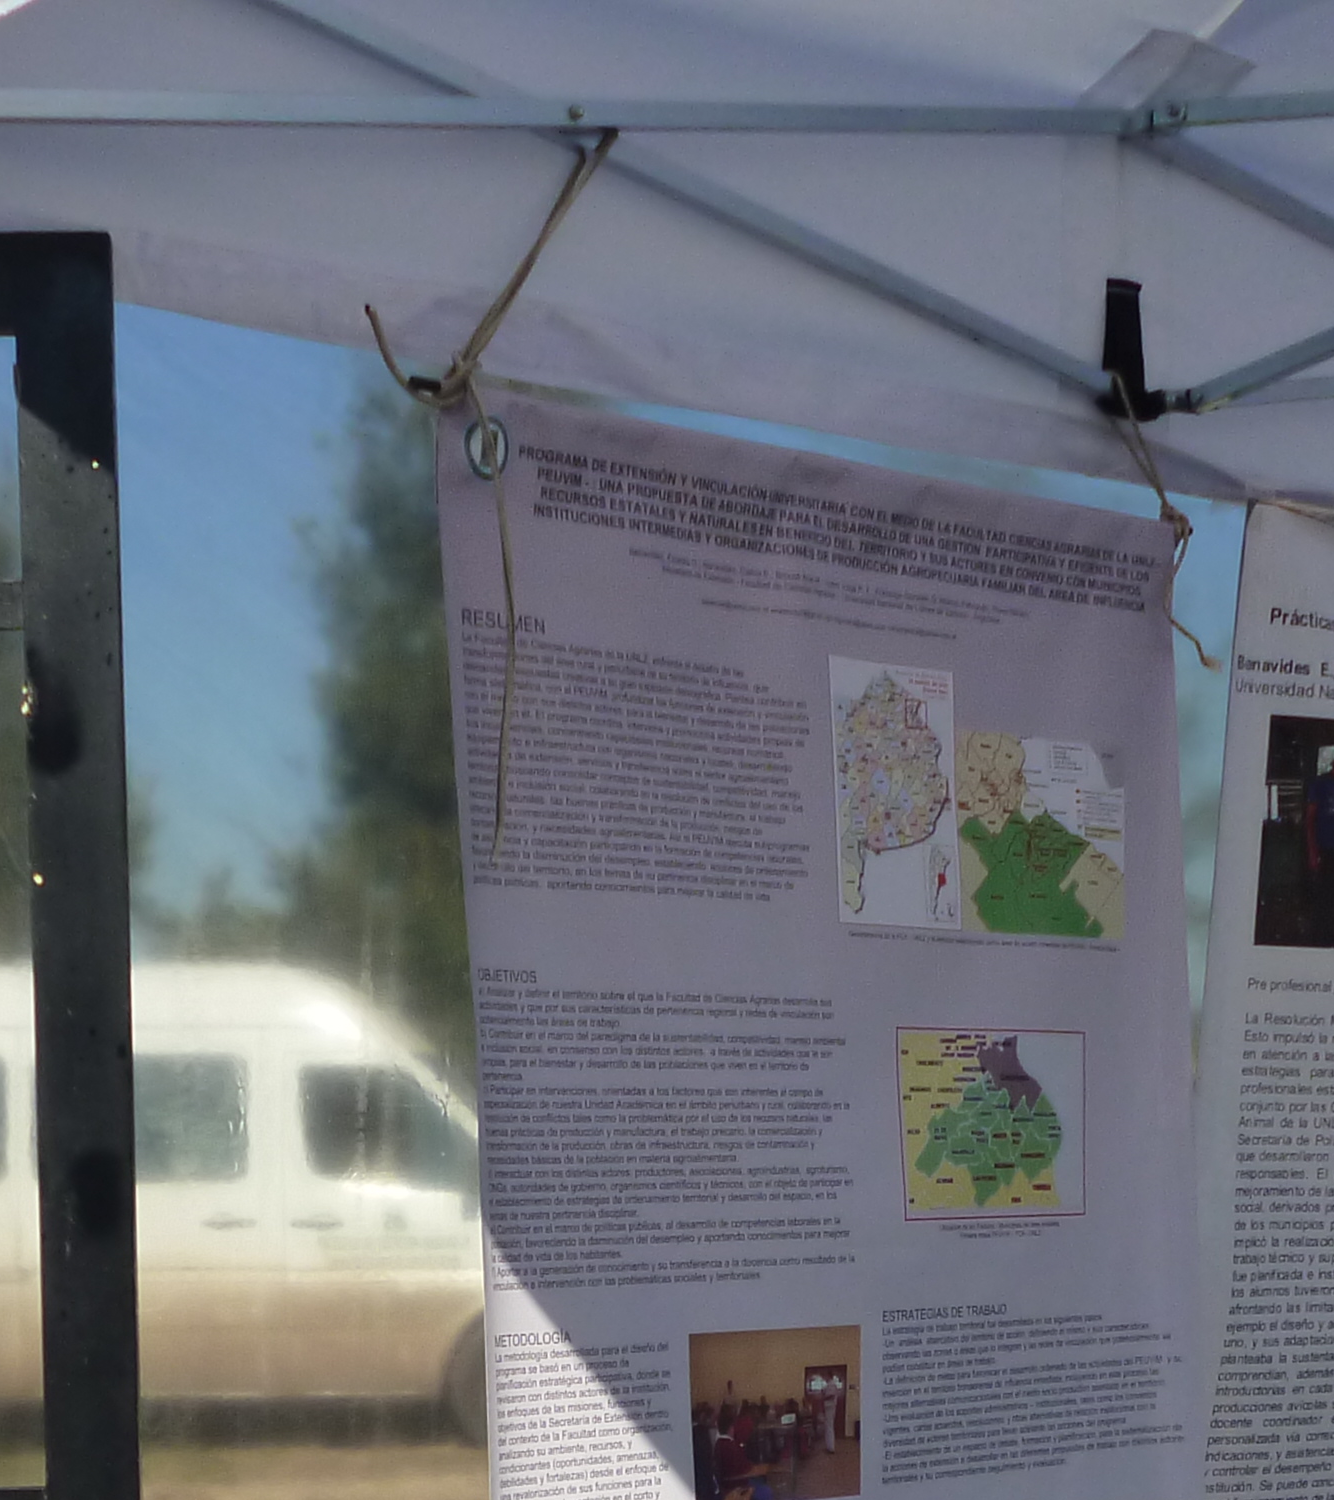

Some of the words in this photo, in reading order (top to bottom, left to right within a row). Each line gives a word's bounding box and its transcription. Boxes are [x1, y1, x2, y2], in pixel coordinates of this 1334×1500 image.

[518, 444, 588, 470] PROGRAMA
[591, 458, 607, 473] DE
[609, 458, 676, 486] EXTENSIÓN
[680, 473, 687, 487] Y
[691, 472, 767, 499] VINCULACIÓN
[849, 501, 874, 518] CON
[920, 513, 935, 528] DE
[1237, 654, 1310, 676] Benavides
[1235, 679, 1314, 698] Universidad
[478, 969, 537, 983] OBJETIVOS
[1247, 978, 1267, 991] Pre
[882, 1307, 949, 1323] ESTRATEGIAS
[950, 1306, 963, 1318] DE
[966, 1303, 1007, 1317] TRABAJO
[494, 1329, 571, 1348] METODOLOGÍA
